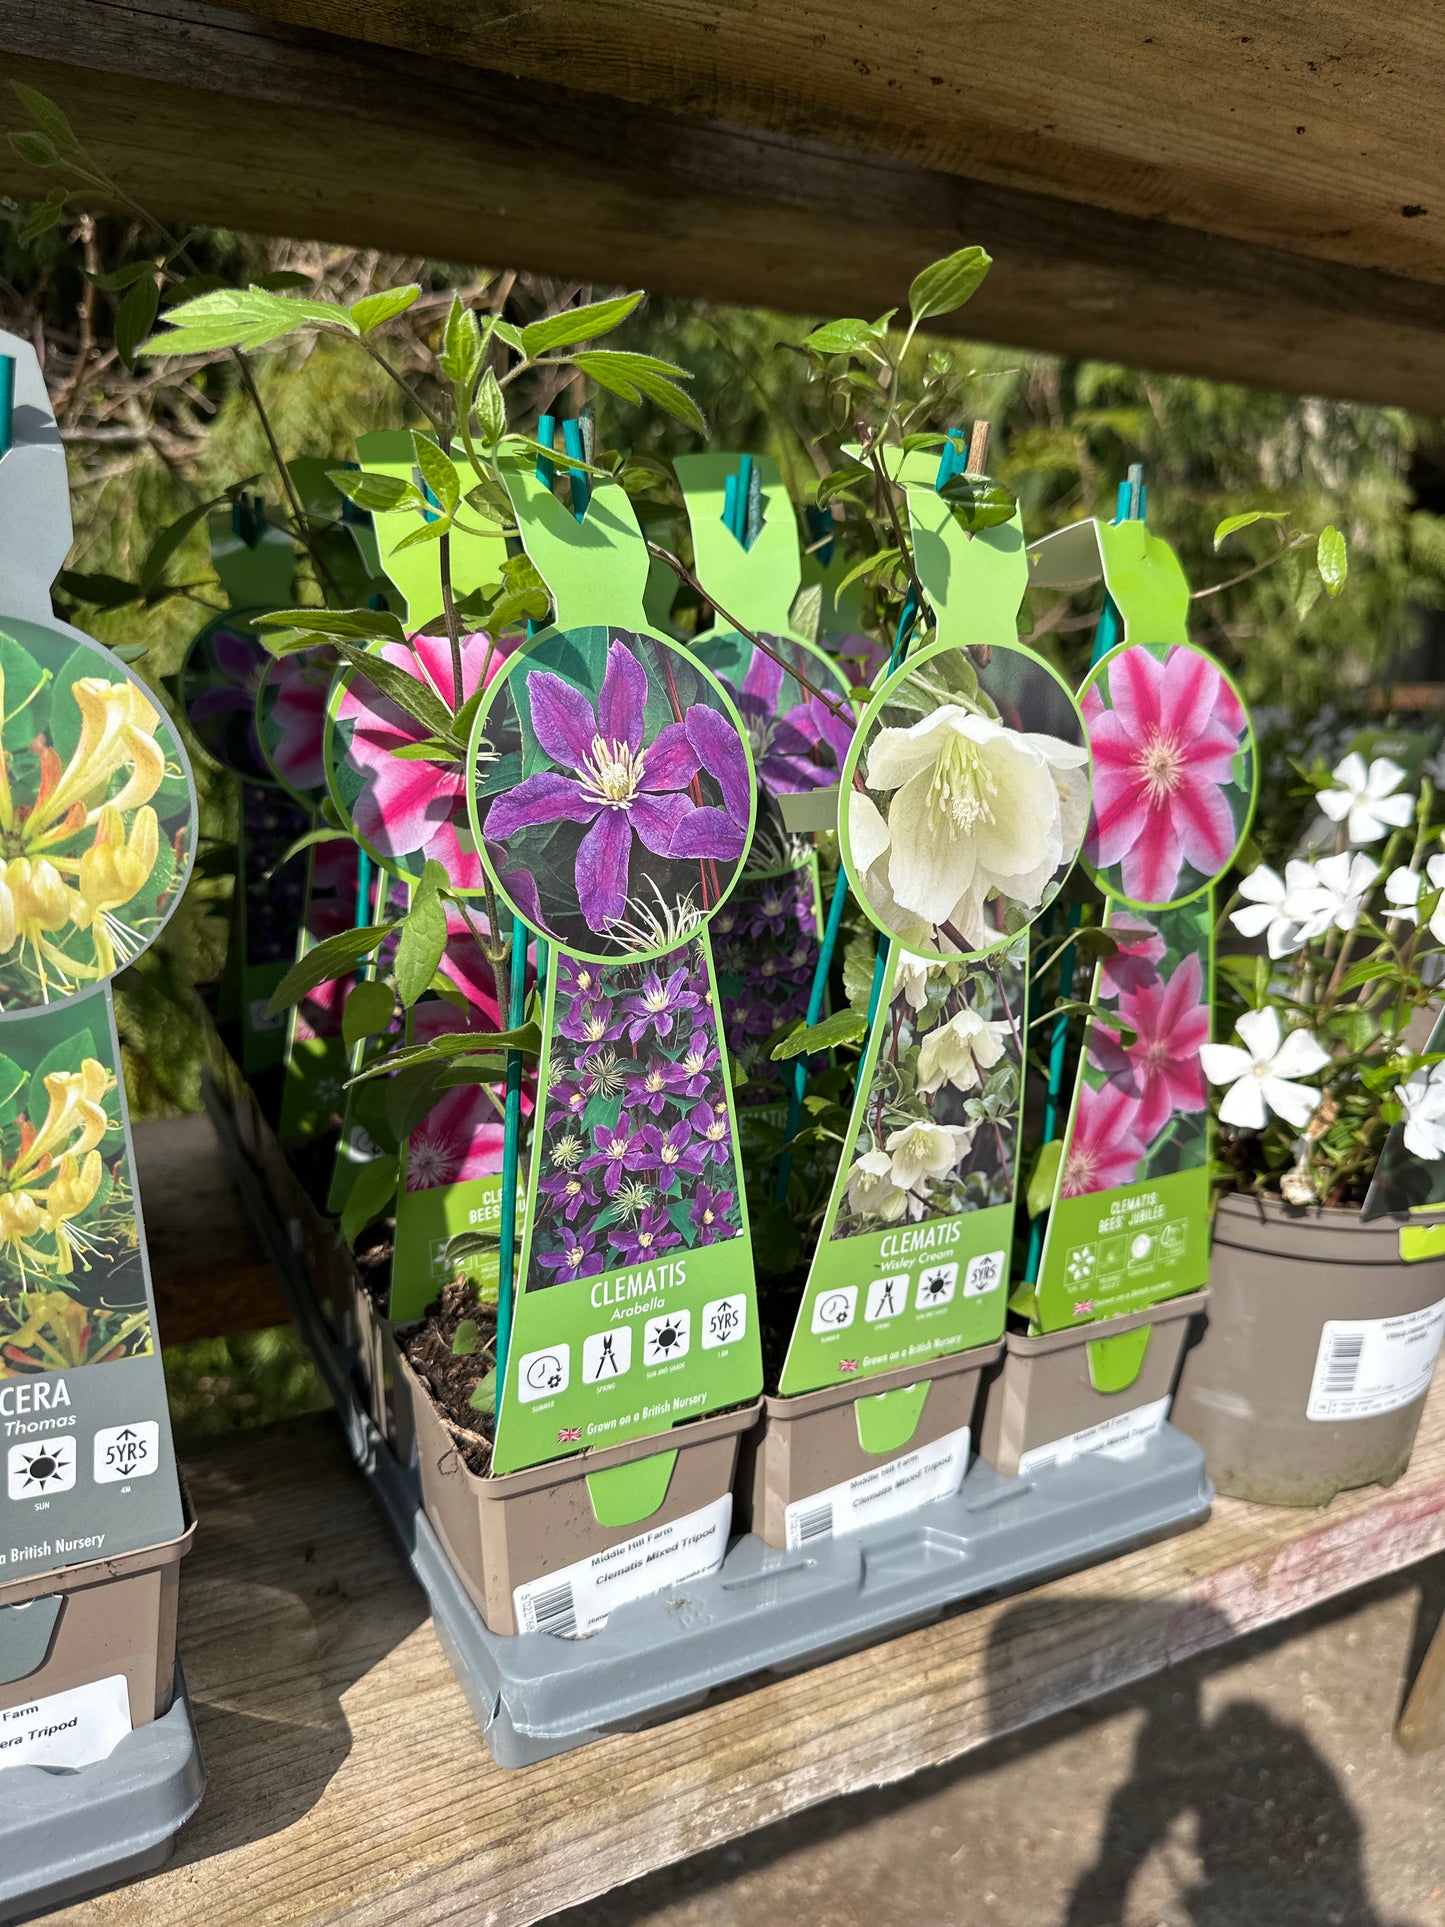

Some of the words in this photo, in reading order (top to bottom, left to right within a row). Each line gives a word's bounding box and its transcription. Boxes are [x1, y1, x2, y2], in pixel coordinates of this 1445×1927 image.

[1110, 1191, 1160, 1216] CLEMATIS
[1128, 1204, 1166, 1227] JUBILEE
[880, 1220, 962, 1258] CLEMATIS
[881, 1257, 915, 1273] Wisley
[918, 1248, 954, 1264] Cream
[590, 1260, 687, 1309] CLEMATIS
[971, 1263, 998, 1284] 5YRS
[610, 1296, 666, 1322] Arabella
[709, 1310, 739, 1333] 5YRS
[862, 1353, 888, 1368] Grown
[0, 1378, 72, 1417] CERA
[4, 1414, 77, 1436] Thomas
[586, 1418, 617, 1436] Grown
[619, 1414, 631, 1425] on
[634, 1412, 640, 1421] a
[642, 1400, 671, 1419] British
[673, 1392, 708, 1410] Nursery
[105, 1440, 148, 1465] 5YRS
[34, 1502, 51, 1511] SUN
[11, 1540, 52, 1562] British
[55, 1534, 105, 1554] Nursery
[591, 1548, 626, 1567] Middle
[628, 1537, 645, 1554] Hill
[647, 1526, 673, 1543] Farm
[595, 1558, 644, 1585] Clematis
[646, 1541, 679, 1563] Mixed
[681, 1523, 717, 1547] Tripod
[3, 1704, 39, 1722] Farm
[0, 1736, 23, 1750] era
[28, 1717, 79, 1741] Tripod
